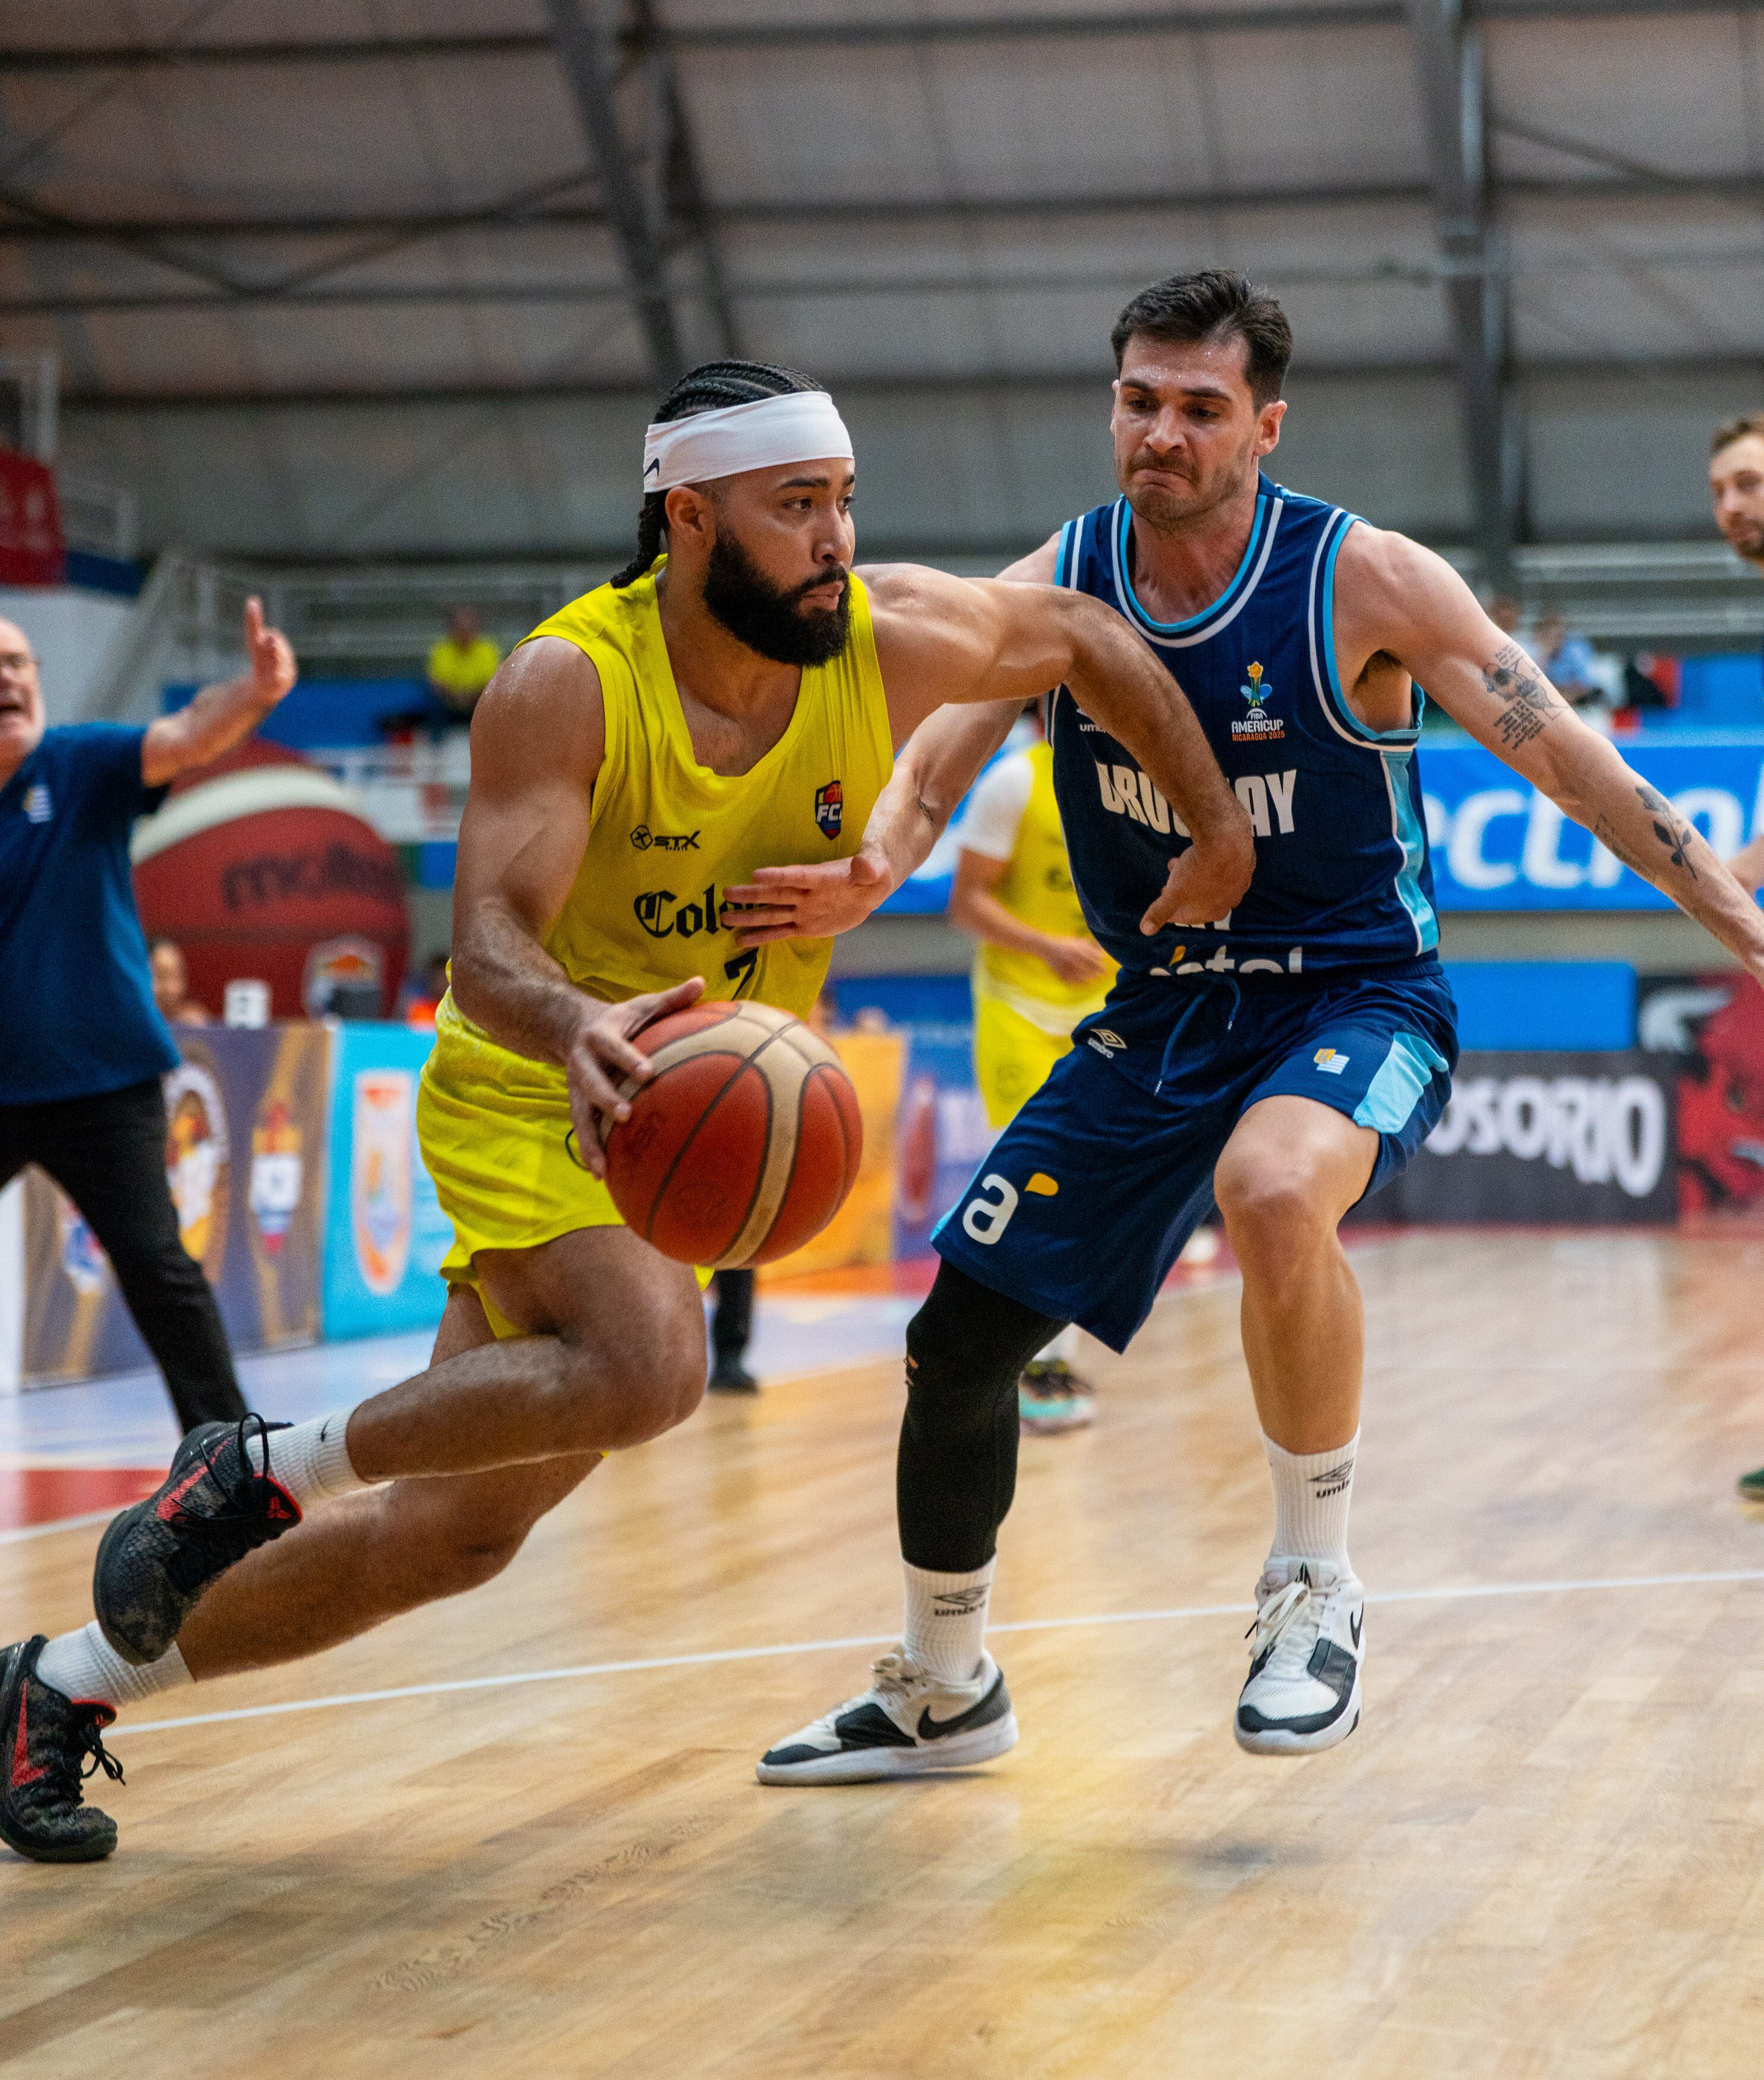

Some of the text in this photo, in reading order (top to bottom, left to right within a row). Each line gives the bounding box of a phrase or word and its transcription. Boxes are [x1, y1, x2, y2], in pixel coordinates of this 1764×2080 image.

[1232, 718, 1284, 733] AMERICUP
[1232, 732, 1267, 742] NICARAGUA
[1095, 759, 1297, 838] URUAY
[816, 803, 842, 822] FC
[654, 830, 701, 849] STX
[724, 946, 760, 1001] 7
[1316, 1479, 1352, 1498] umb
